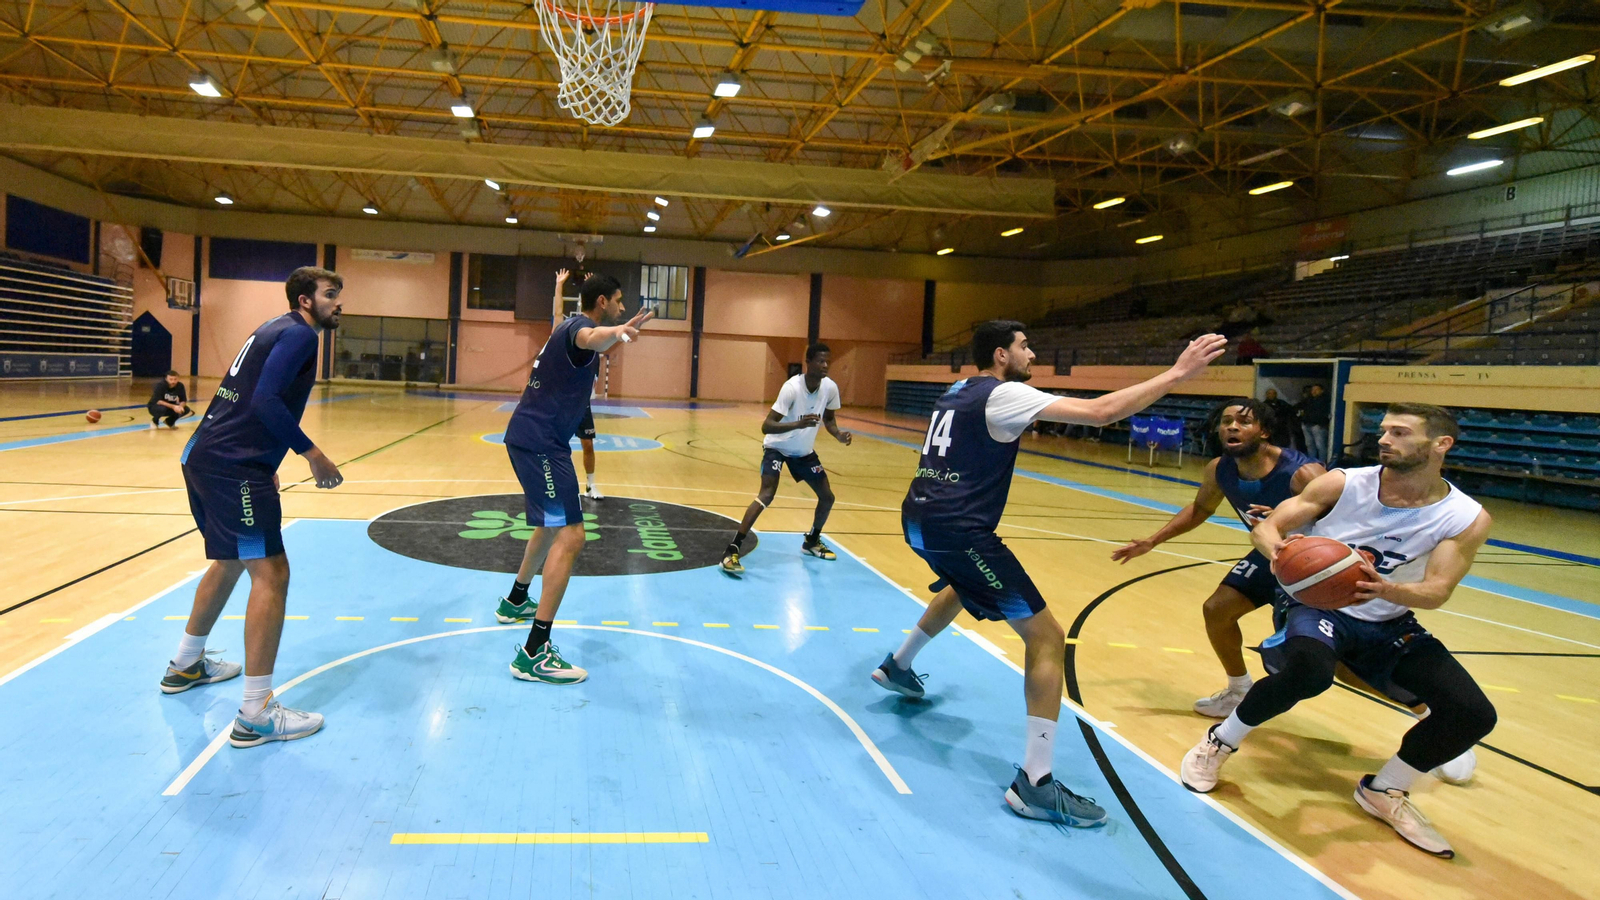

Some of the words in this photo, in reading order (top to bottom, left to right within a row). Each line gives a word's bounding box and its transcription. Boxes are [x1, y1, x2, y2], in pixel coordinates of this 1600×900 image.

[1506, 187, 1516, 200] B
[229, 335, 256, 377] 0
[1397, 371, 1437, 379] PRENSA
[1477, 372, 1490, 380] TV
[922, 410, 955, 457] 14
[240, 480, 254, 526] damex
[965, 547, 1003, 590] damex
[1231, 559, 1258, 578] 21
